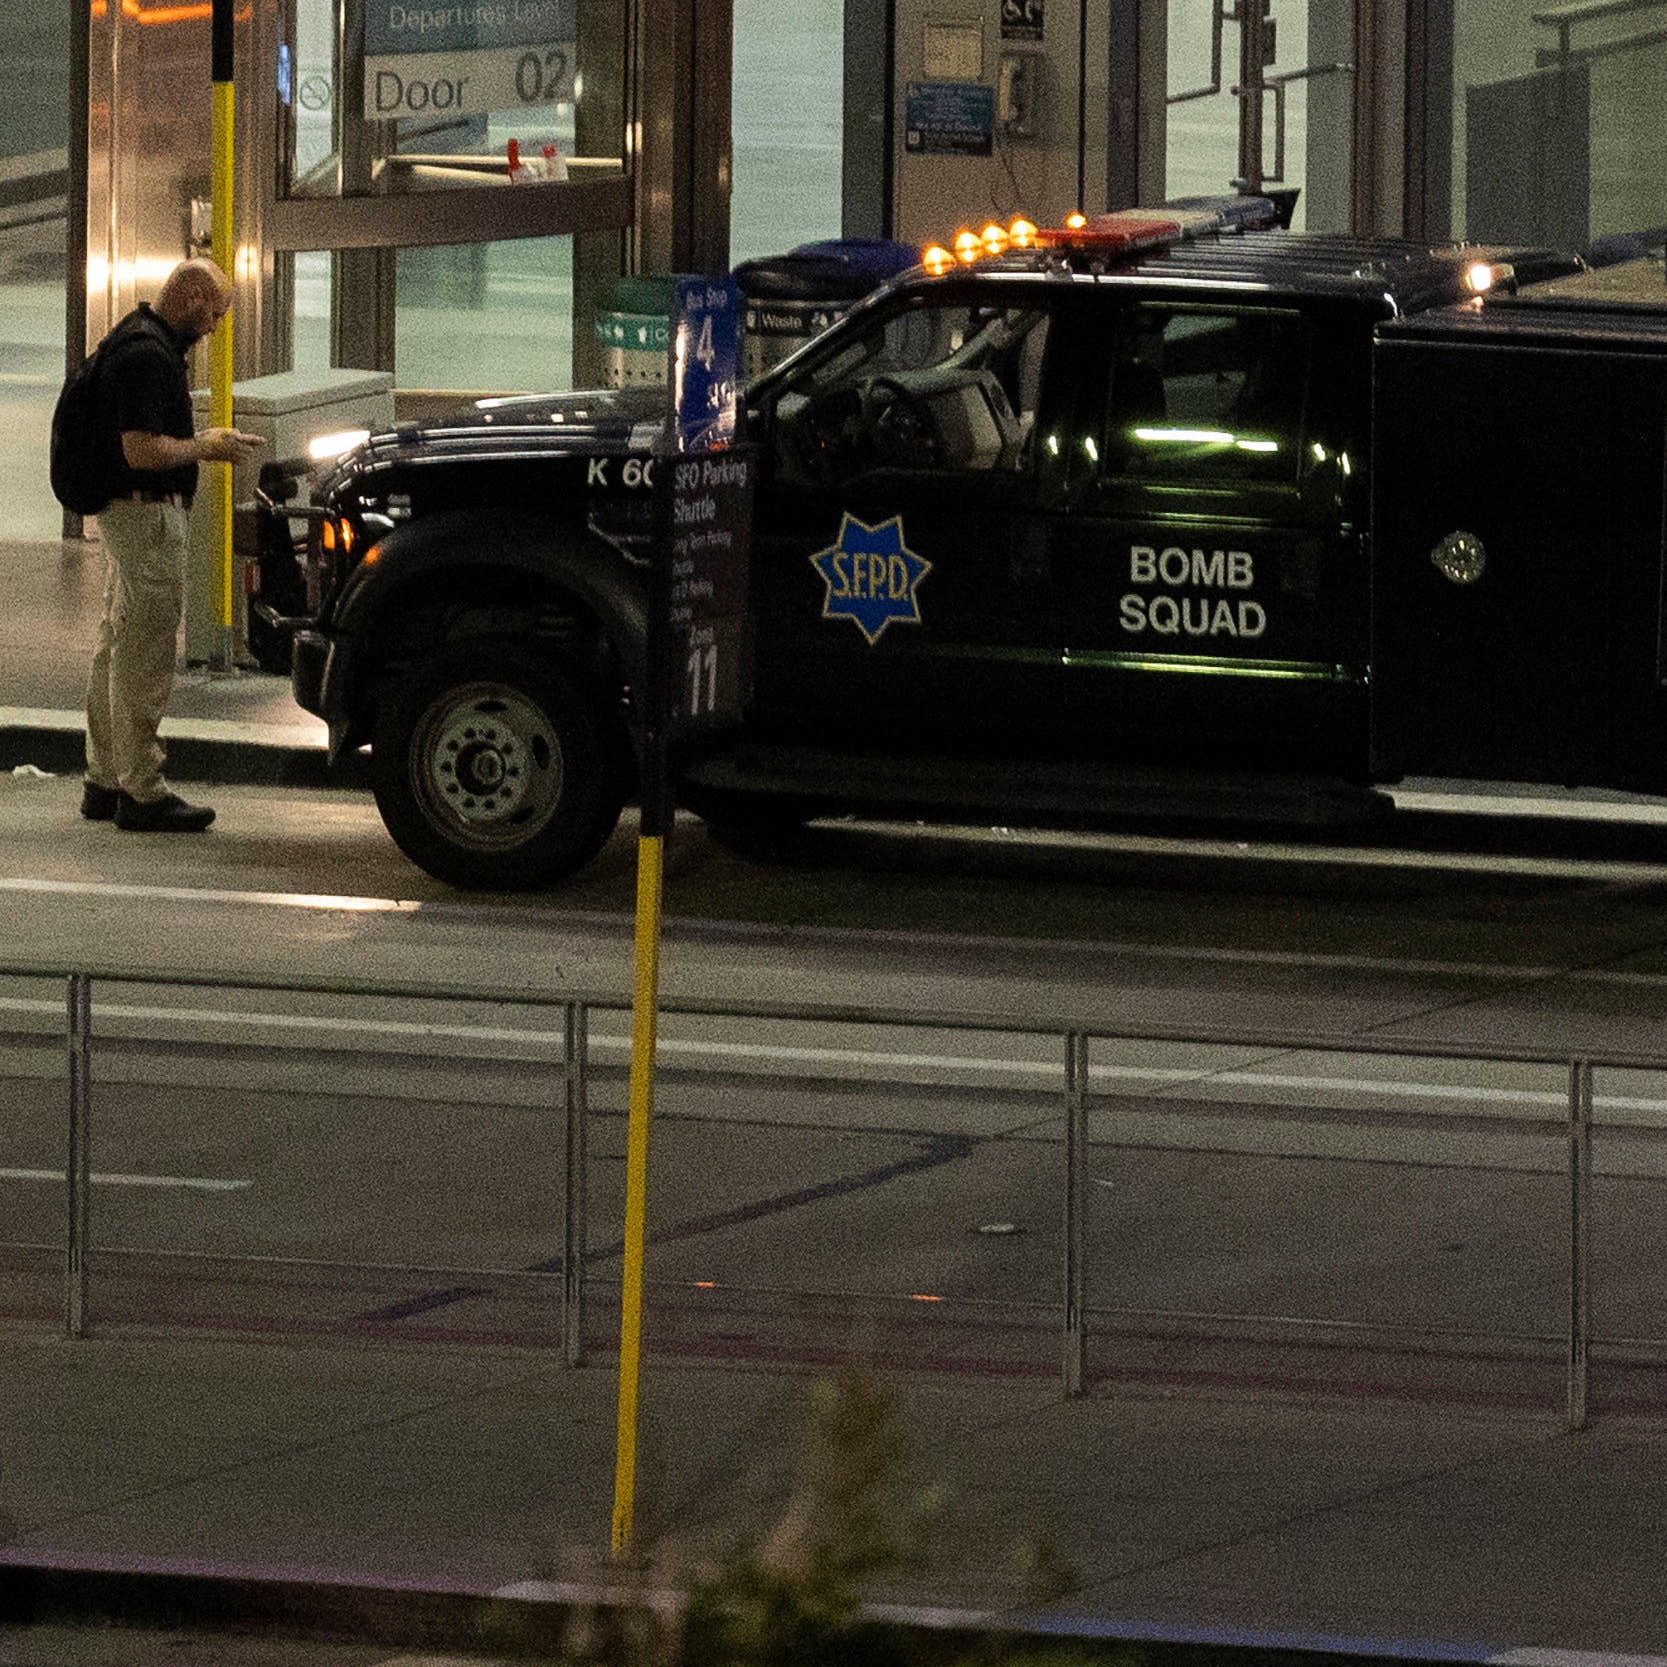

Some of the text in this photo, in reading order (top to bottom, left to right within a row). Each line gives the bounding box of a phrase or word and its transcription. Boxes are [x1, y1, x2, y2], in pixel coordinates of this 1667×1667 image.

[389, 3, 506, 33] Departures
[376, 50, 568, 111] Door 02
[761, 313, 802, 328] Waste
[696, 314, 715, 372] 4
[587, 457, 609, 486] K
[674, 457, 747, 490] SFO Parking
[673, 493, 717, 524] Shuttle
[1131, 546, 1254, 589] BOMB
[1119, 593, 1267, 638] SQUAD
[687, 645, 718, 716] 11
